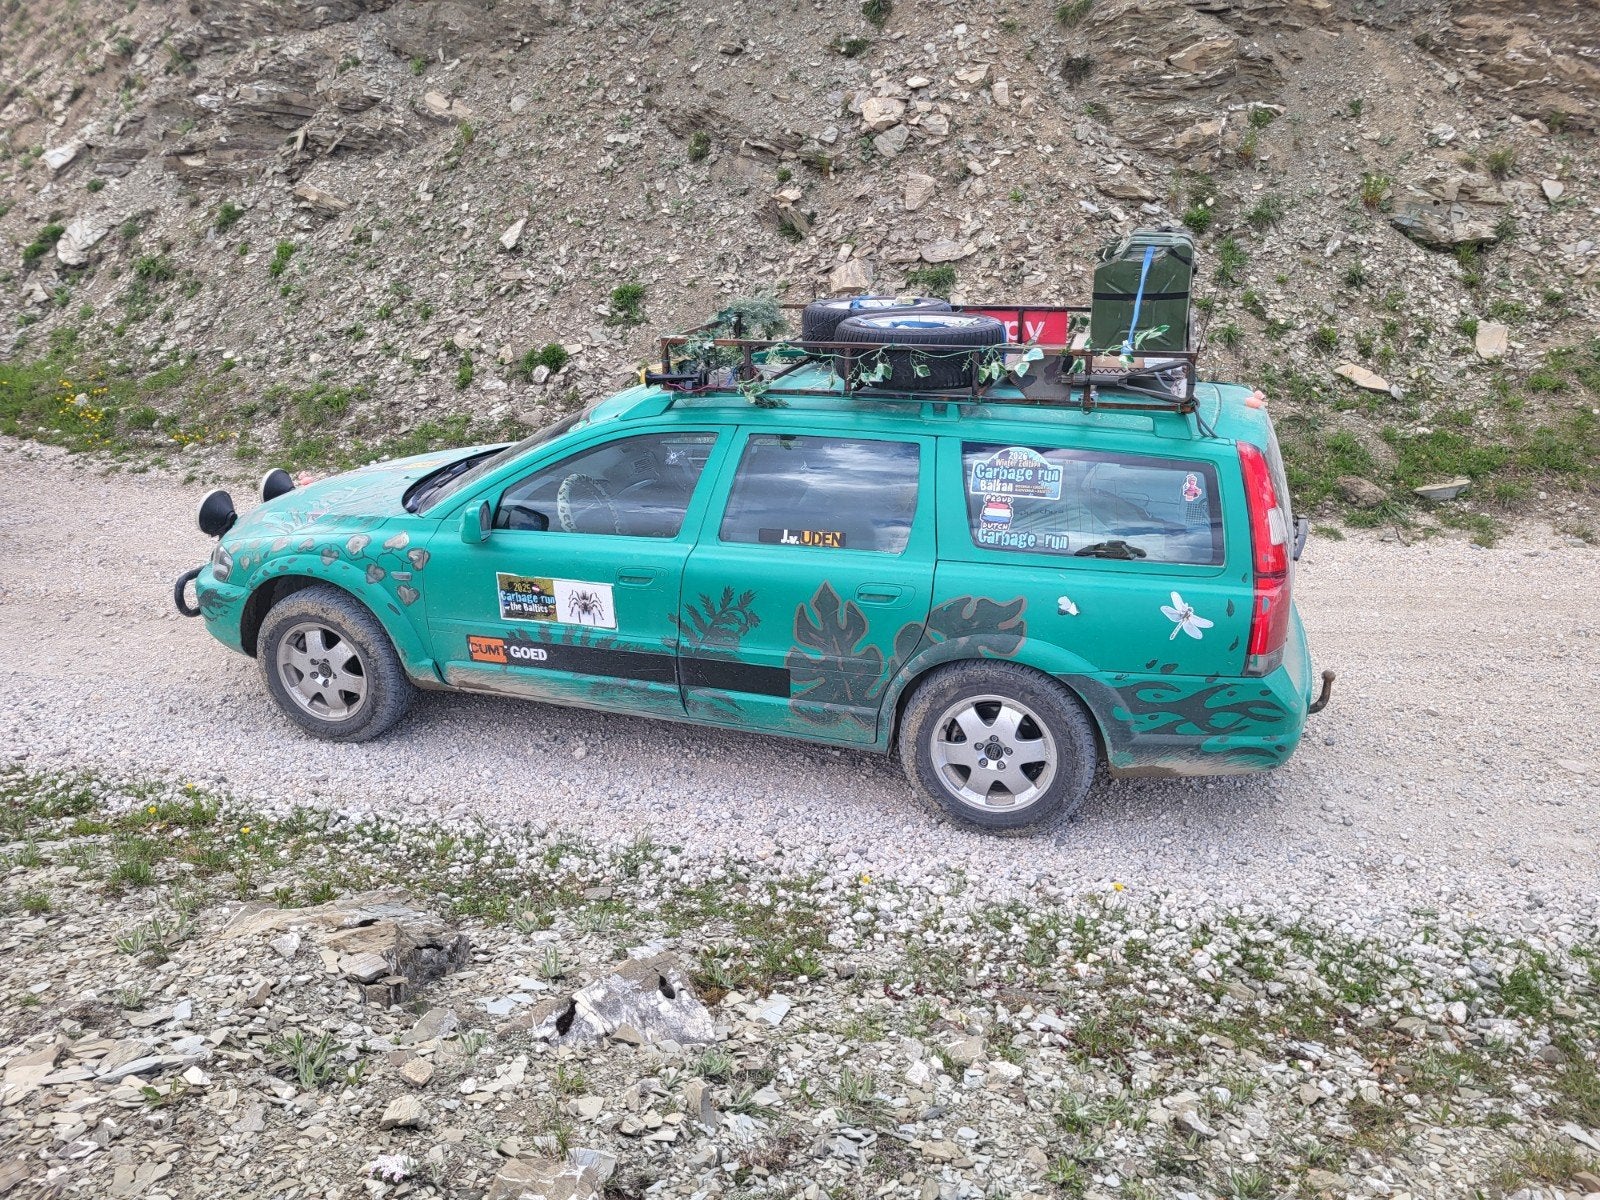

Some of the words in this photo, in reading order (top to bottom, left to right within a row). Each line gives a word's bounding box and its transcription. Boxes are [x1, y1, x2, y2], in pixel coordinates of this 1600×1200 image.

[1009, 451, 1028, 461] 2026
[995, 458, 1017, 467] Winter
[1018, 459, 1041, 468] Edition
[975, 463, 1033, 482] Carbage
[1038, 468, 1060, 482] run
[980, 479, 1013, 492] Balkan
[985, 494, 1012, 502] PROUD
[982, 522, 1009, 530] DUTCH
[801, 530, 841, 547] UDEN
[978, 529, 1037, 548] Carbage
[1044, 533, 1069, 549] run
[513, 582, 532, 593] 2025
[500, 590, 538, 604] Carbage
[541, 595, 556, 605] run
[510, 602, 522, 611] the
[523, 602, 549, 613] Baltics
[509, 645, 548, 661] GOED
